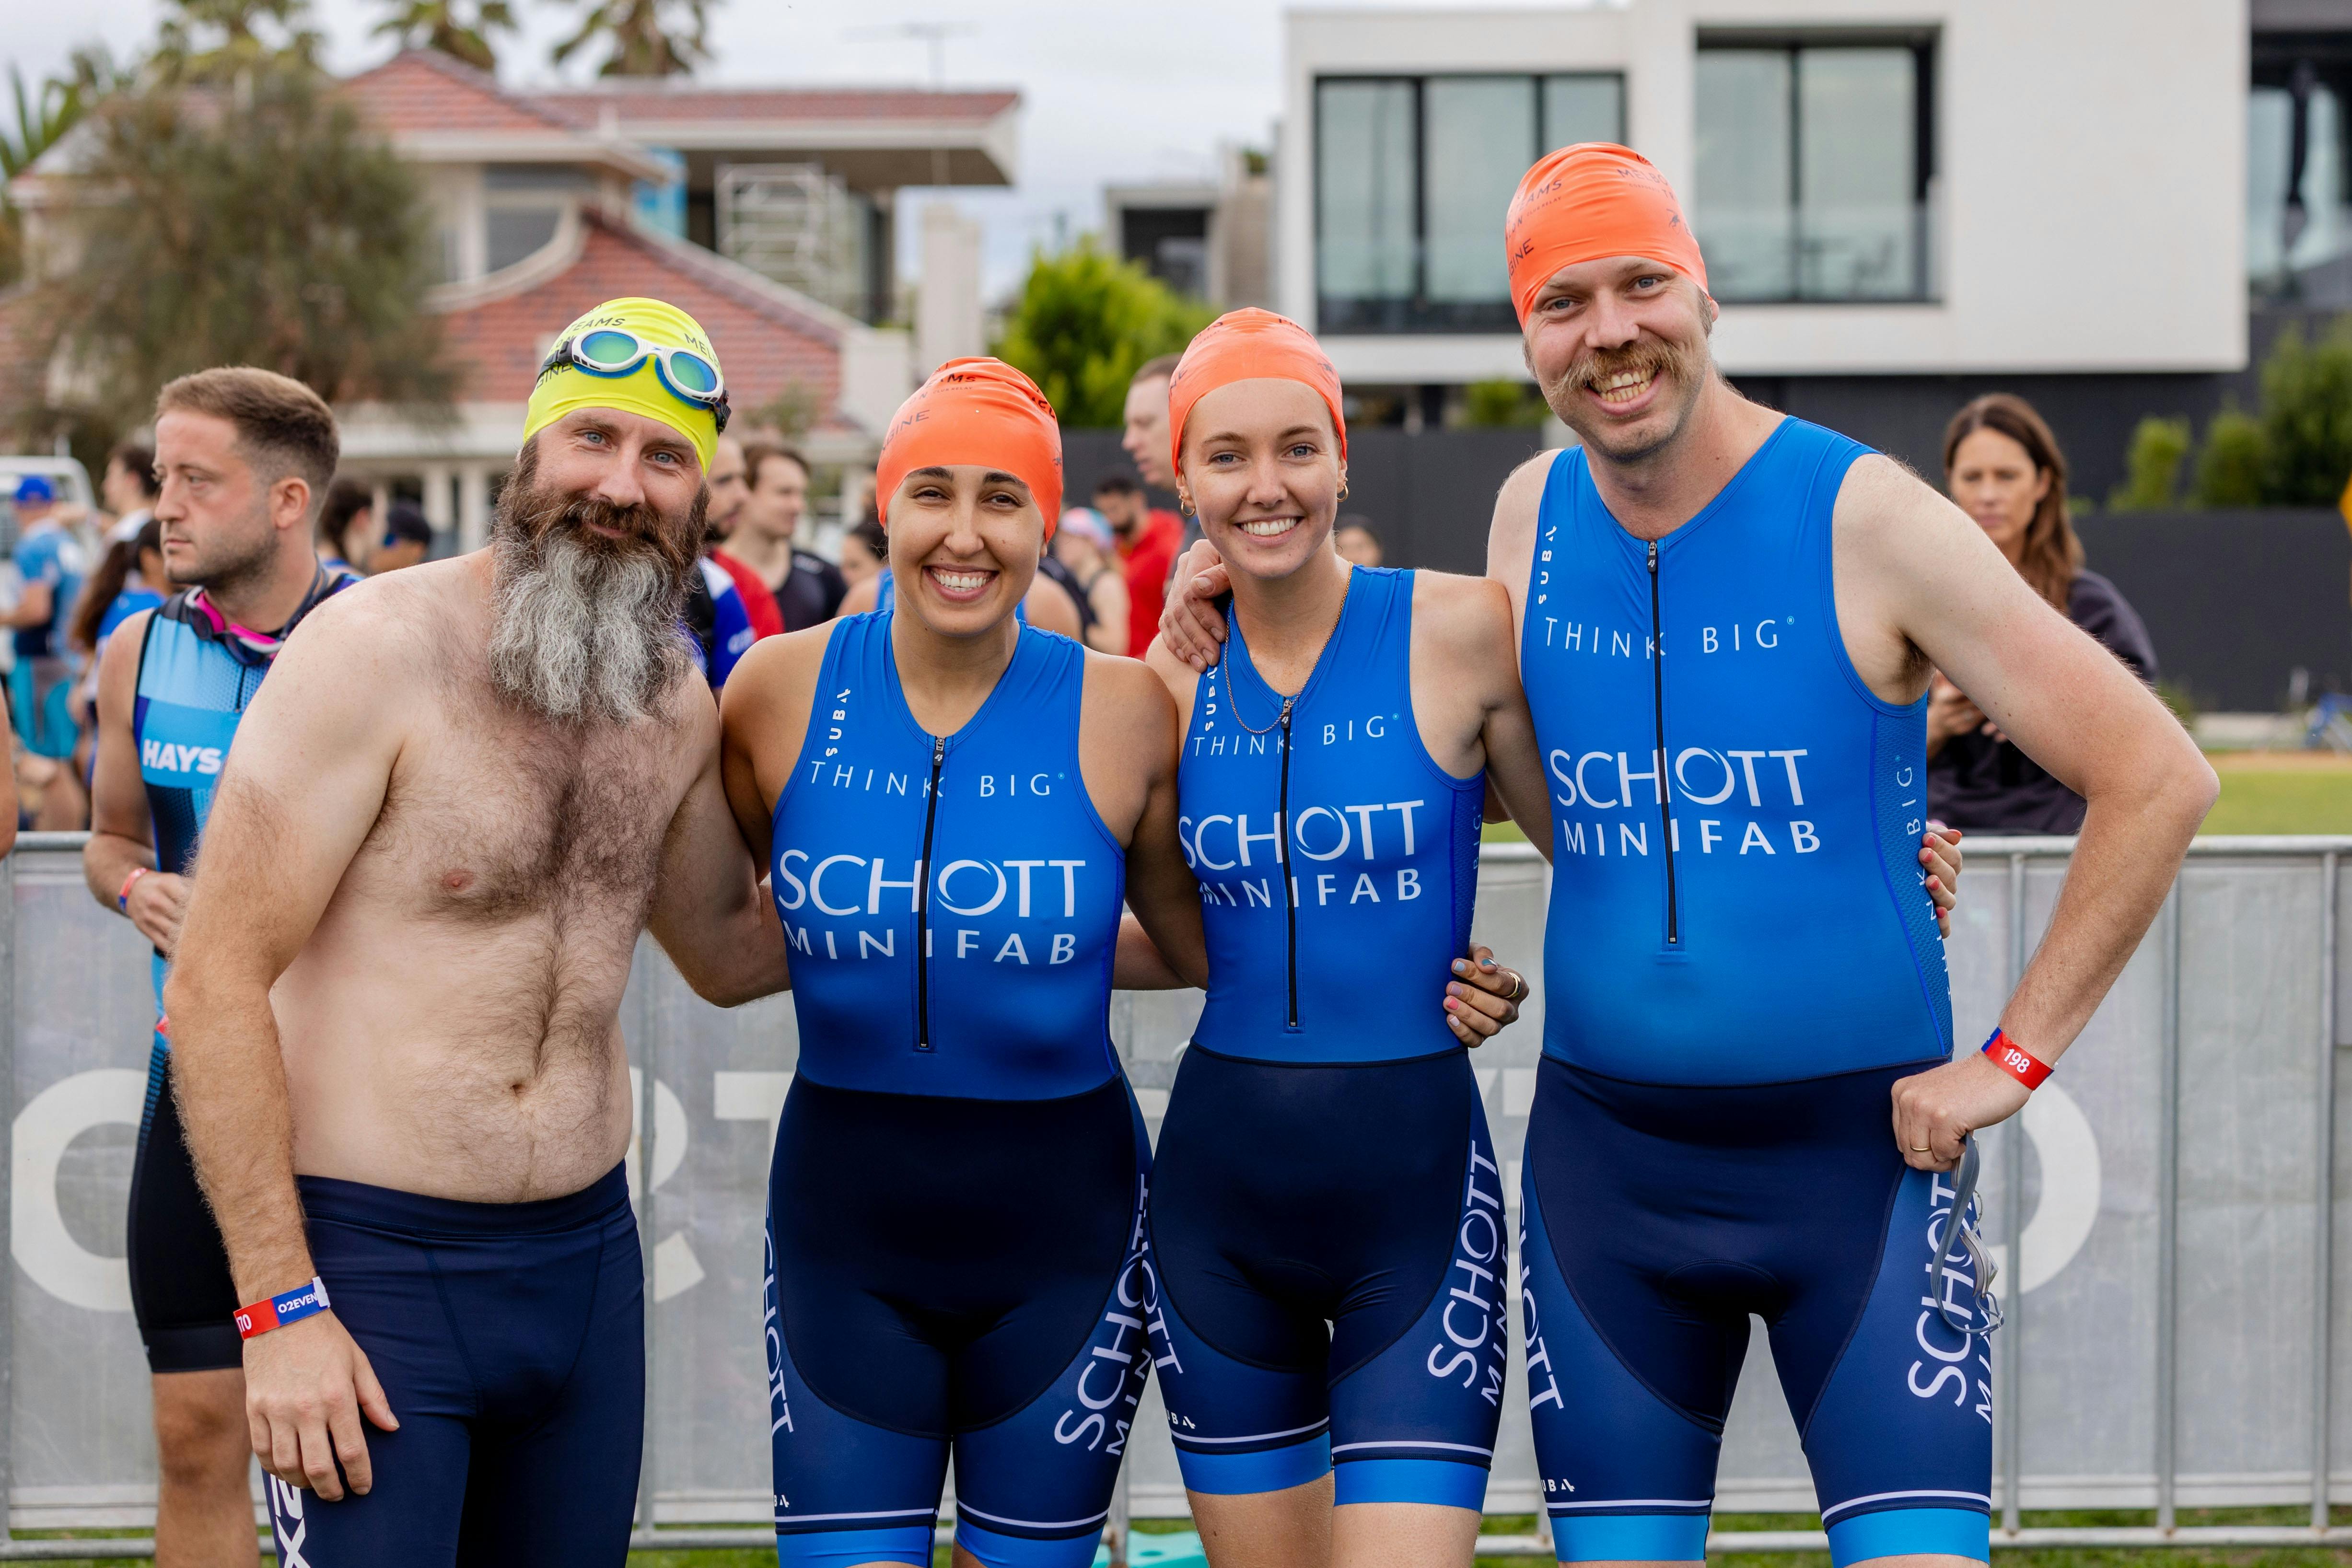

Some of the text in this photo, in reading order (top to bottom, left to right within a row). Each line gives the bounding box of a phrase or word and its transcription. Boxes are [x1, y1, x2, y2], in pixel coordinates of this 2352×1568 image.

[1509, 238, 1534, 280] GINE
[1545, 616, 1666, 660] THINK
[143, 738, 222, 775] HAYS
[1194, 732, 1294, 757] THINK
[811, 761, 944, 798] THINK
[1549, 747, 1808, 809] SCHOTT
[1178, 799, 1424, 871] SCHOTT
[1562, 819, 1821, 857] MINIFAB
[778, 849, 1086, 918] SCHOTT
[1199, 868, 1421, 908] MINIFAB
[782, 919, 1077, 965] MINIFAB
[2003, 1048, 2030, 1073] 198
[1427, 1140, 1499, 1389] SCHOTT
[1907, 1173, 1975, 1407] SCHOT
